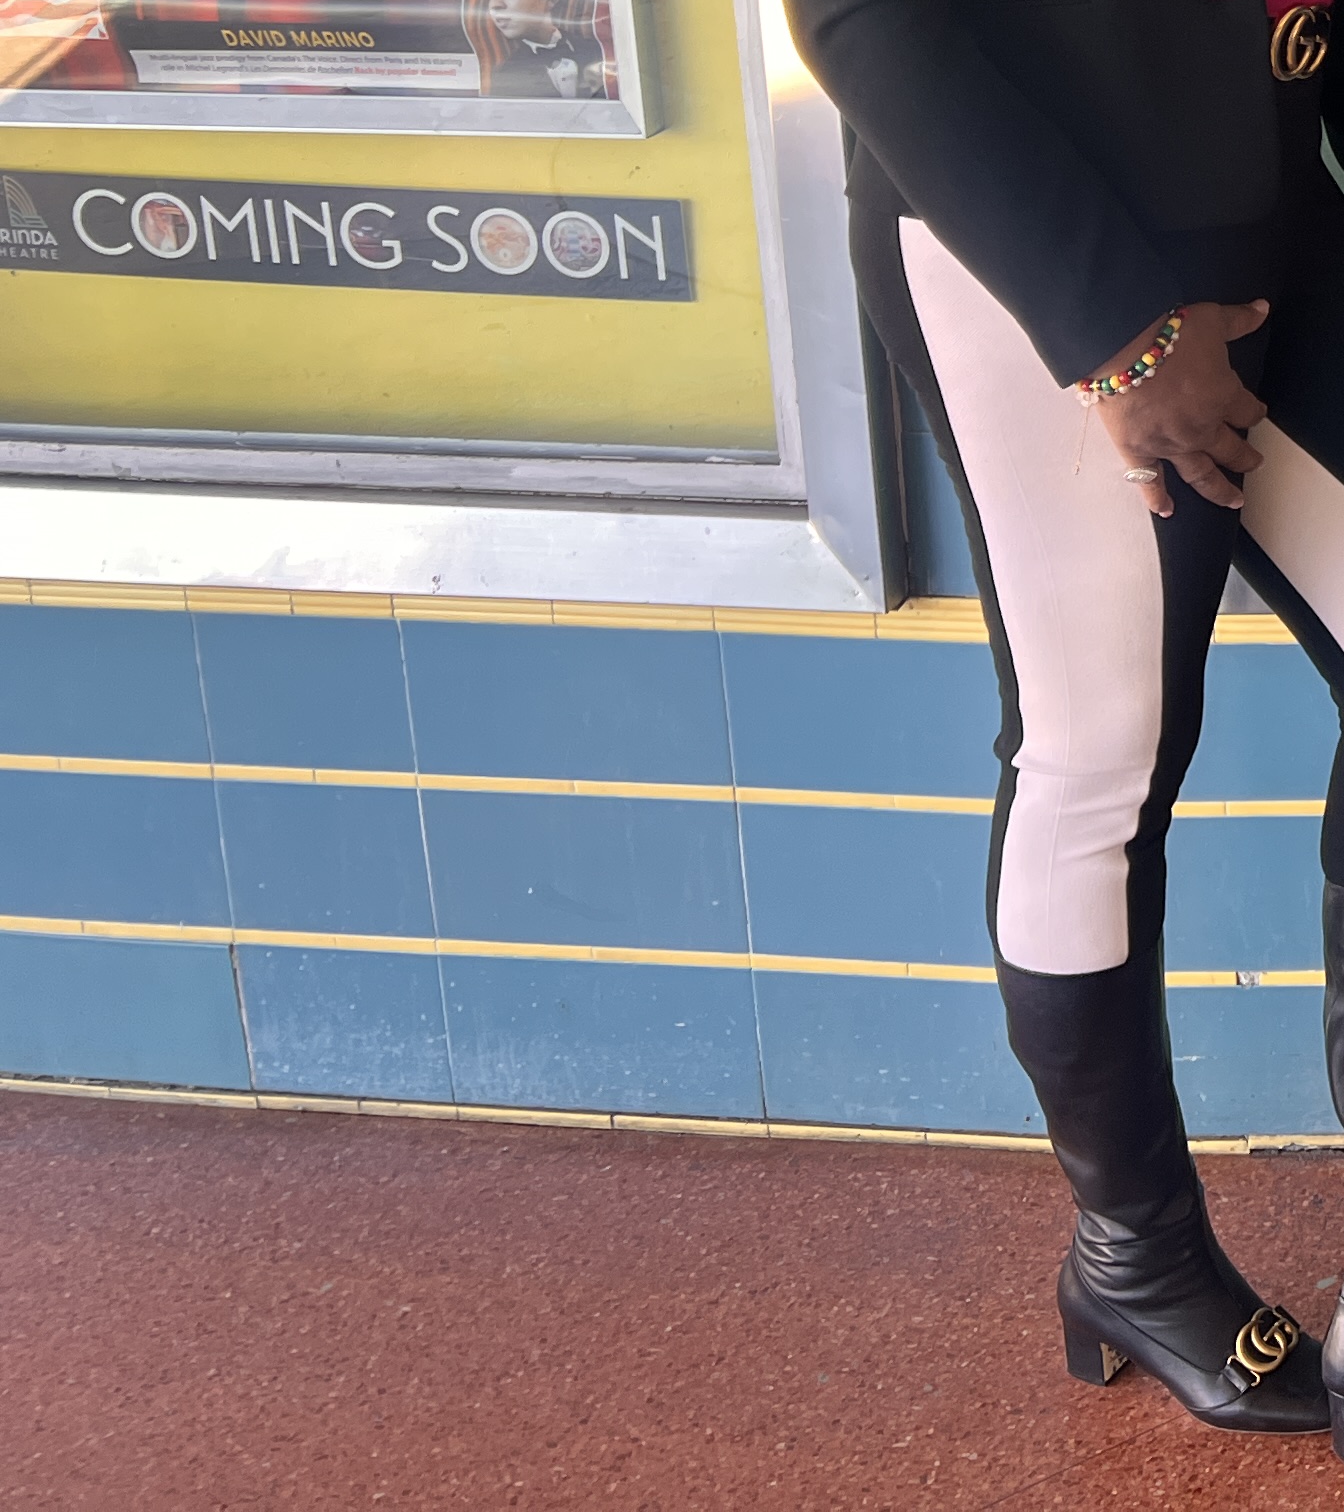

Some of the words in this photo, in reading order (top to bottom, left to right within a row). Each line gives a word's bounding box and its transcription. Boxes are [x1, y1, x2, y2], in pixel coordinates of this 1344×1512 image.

[221, 29, 287, 48] DAVID
[291, 30, 375, 49] MARINO
[73, 189, 402, 270] COMING
[427, 205, 667, 282] SOON
